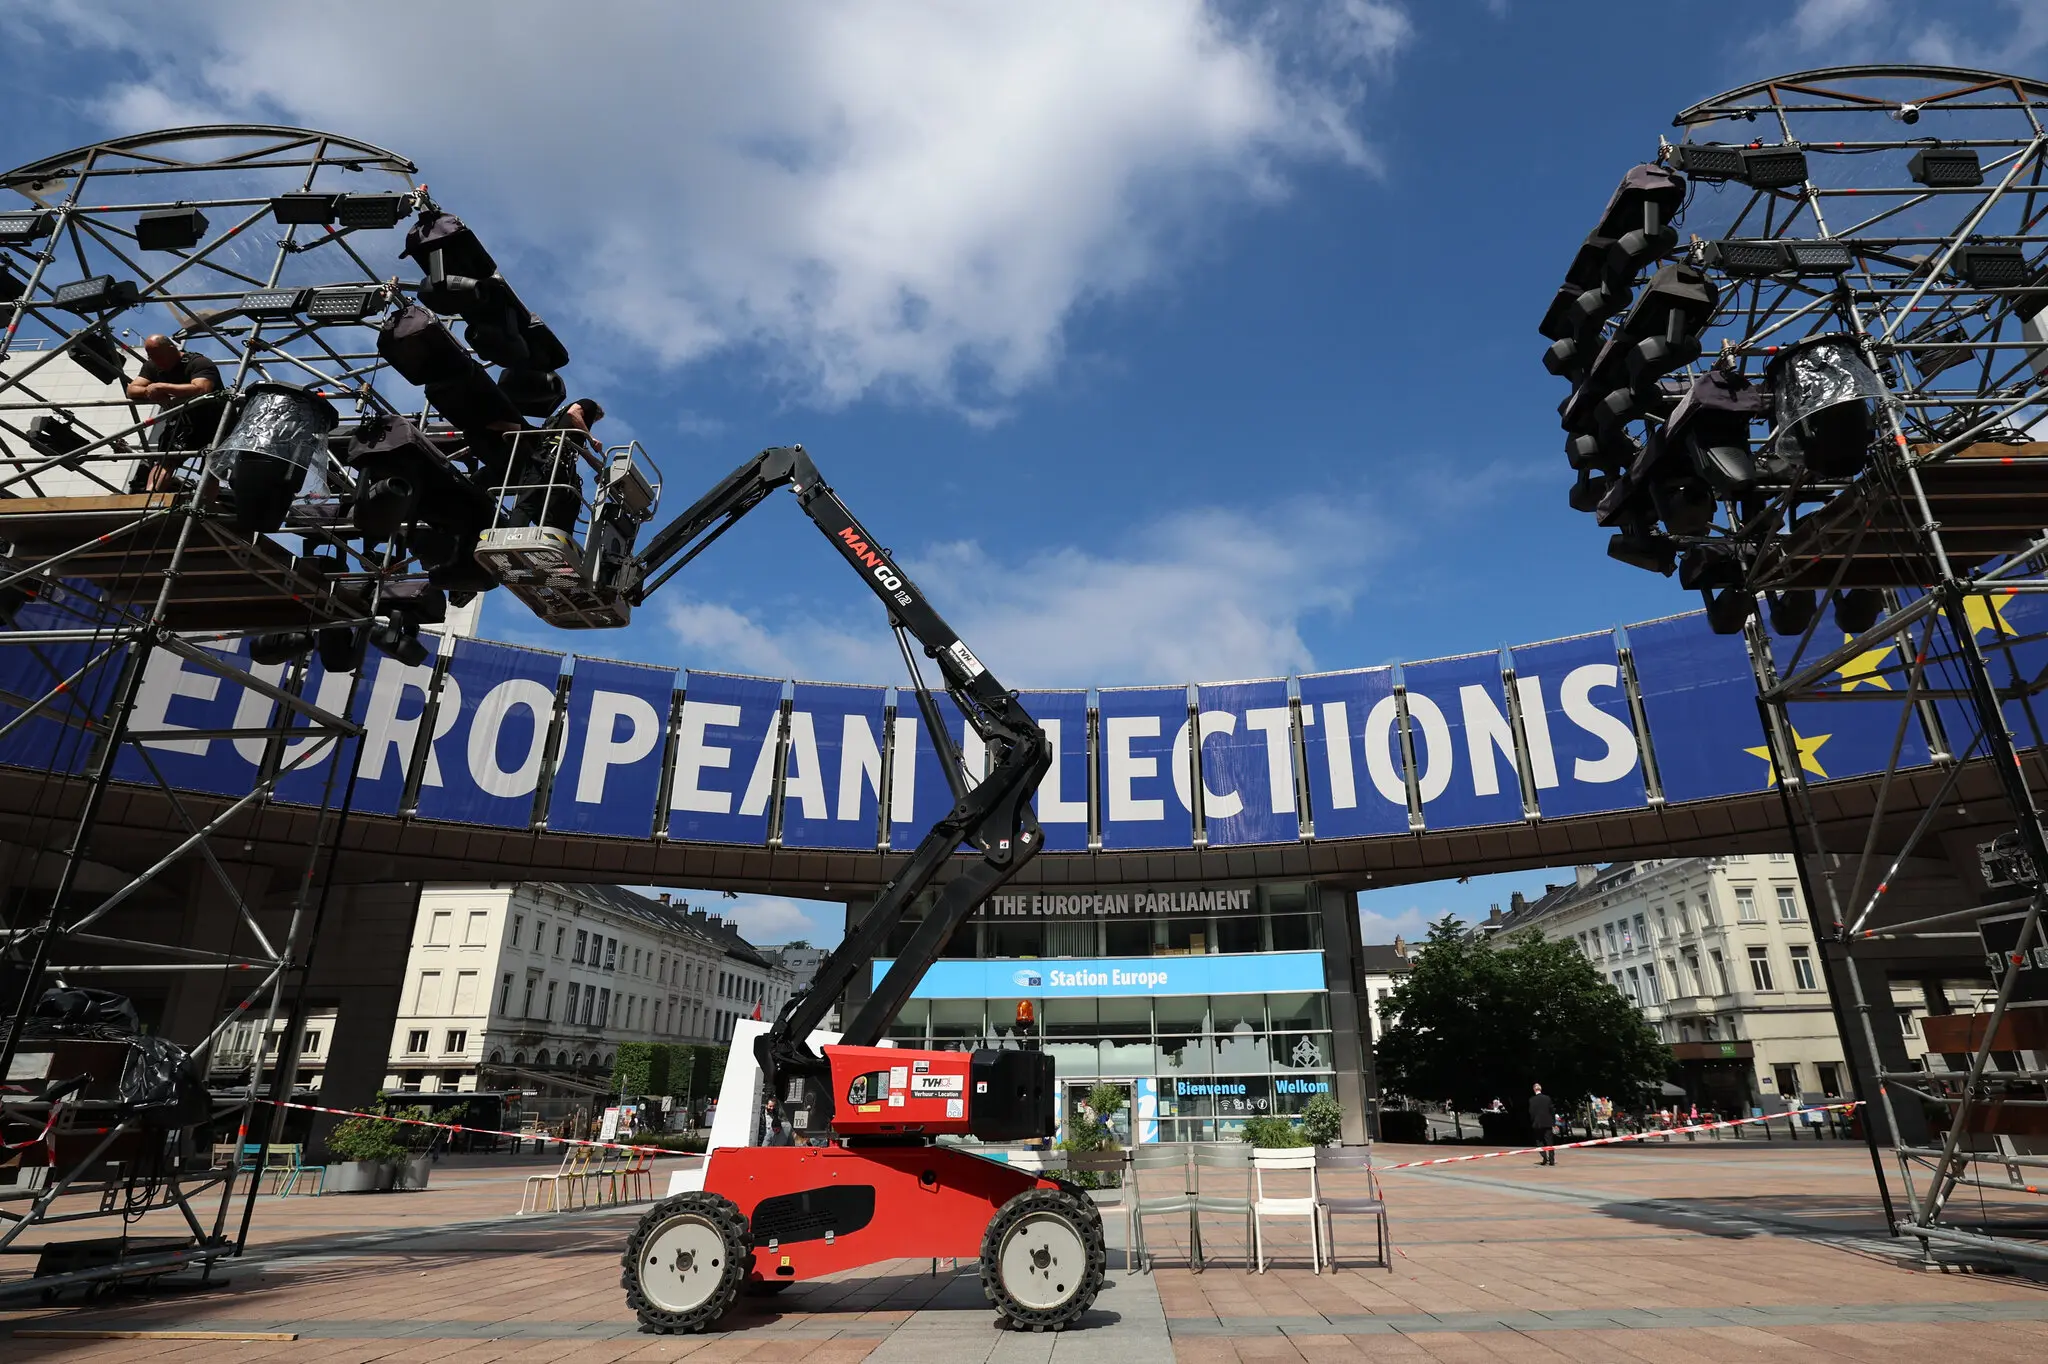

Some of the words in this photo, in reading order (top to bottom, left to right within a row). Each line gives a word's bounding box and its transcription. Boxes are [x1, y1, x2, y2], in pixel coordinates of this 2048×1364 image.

[894, 590, 912, 606] 12
[958, 648, 972, 661] TVH
[126, 633, 917, 823] EUROPEAN
[992, 895, 1027, 915] THE
[1032, 894, 1128, 915] EUROPEAN
[1134, 889, 1250, 914] PARLIAMENT
[1050, 969, 1107, 987] Station
[1112, 968, 1168, 988] Europe
[922, 1078, 942, 1087] TVH
[1178, 1081, 1246, 1096] Bienvenue
[1275, 1079, 1329, 1095] Welkom
